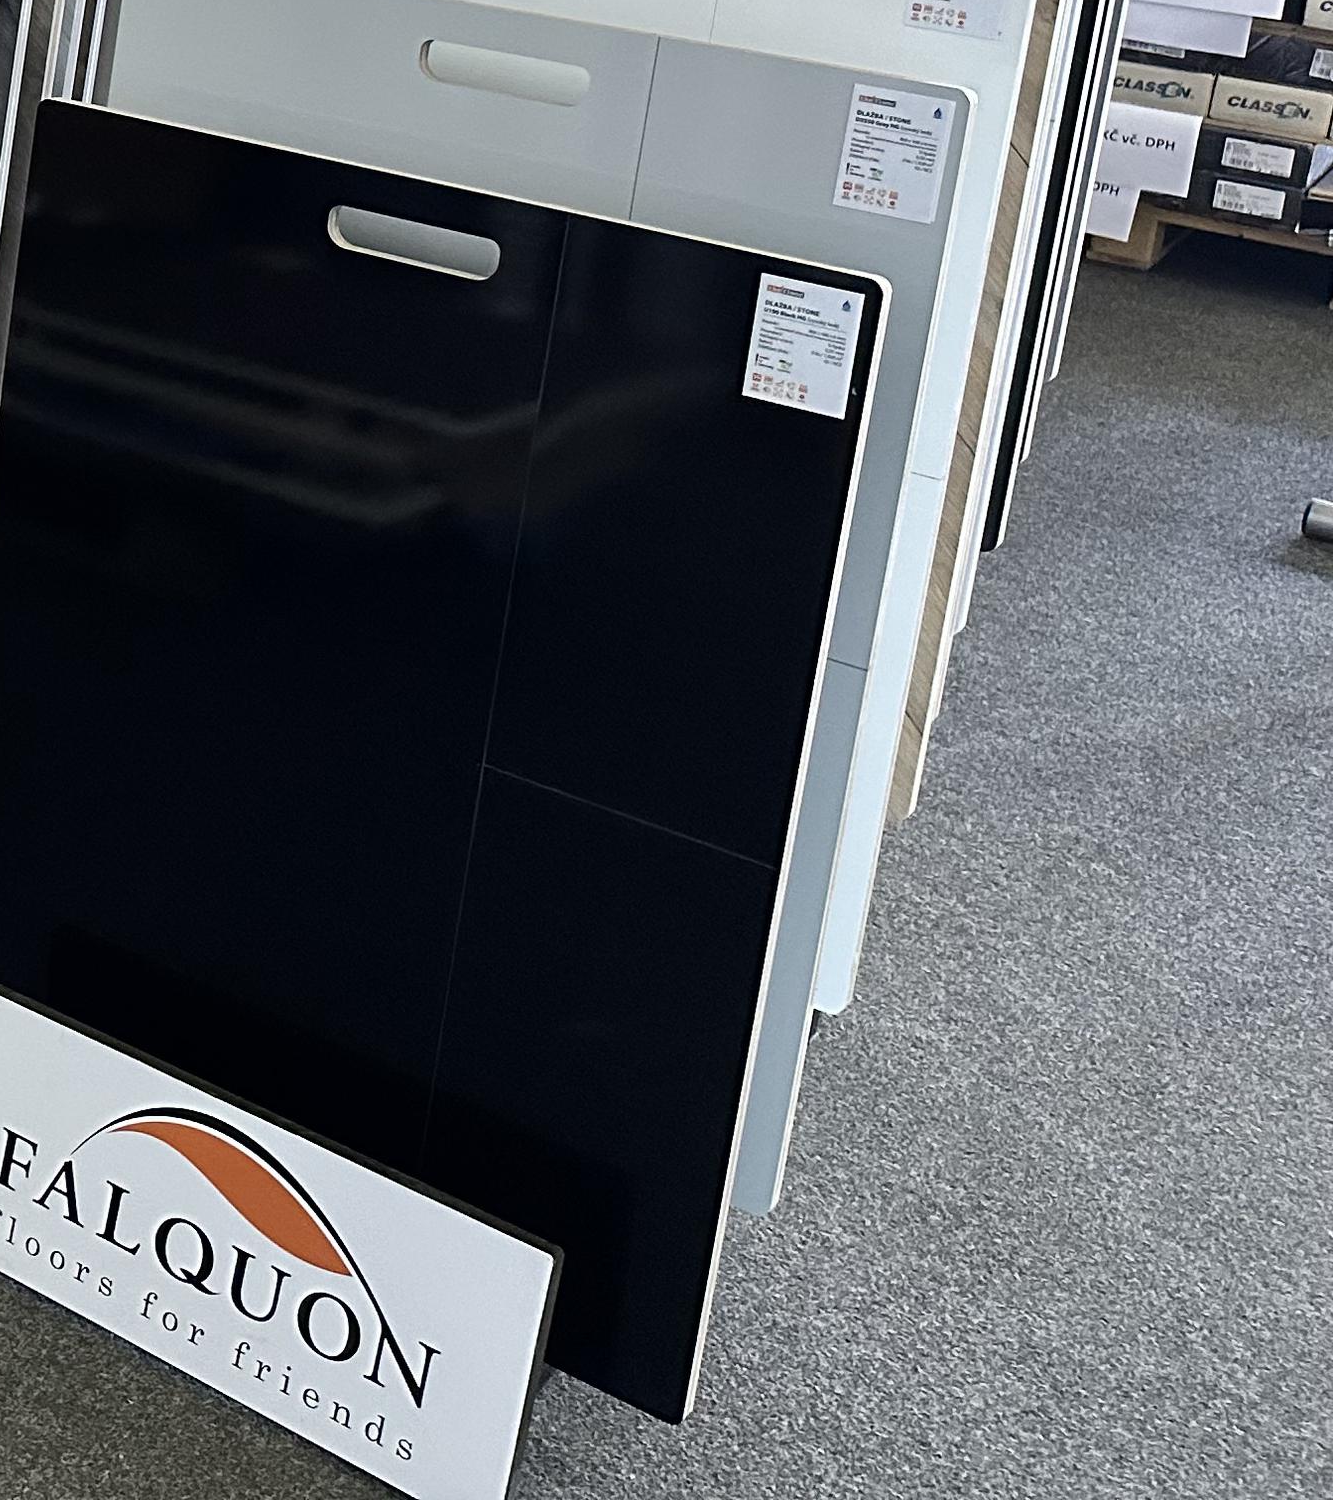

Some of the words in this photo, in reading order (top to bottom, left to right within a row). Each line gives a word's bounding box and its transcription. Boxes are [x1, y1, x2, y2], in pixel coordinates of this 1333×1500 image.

[1145, 136, 1176, 151] DPH
[139, 1292, 206, 1347] for
[232, 1341, 414, 1463] friends
